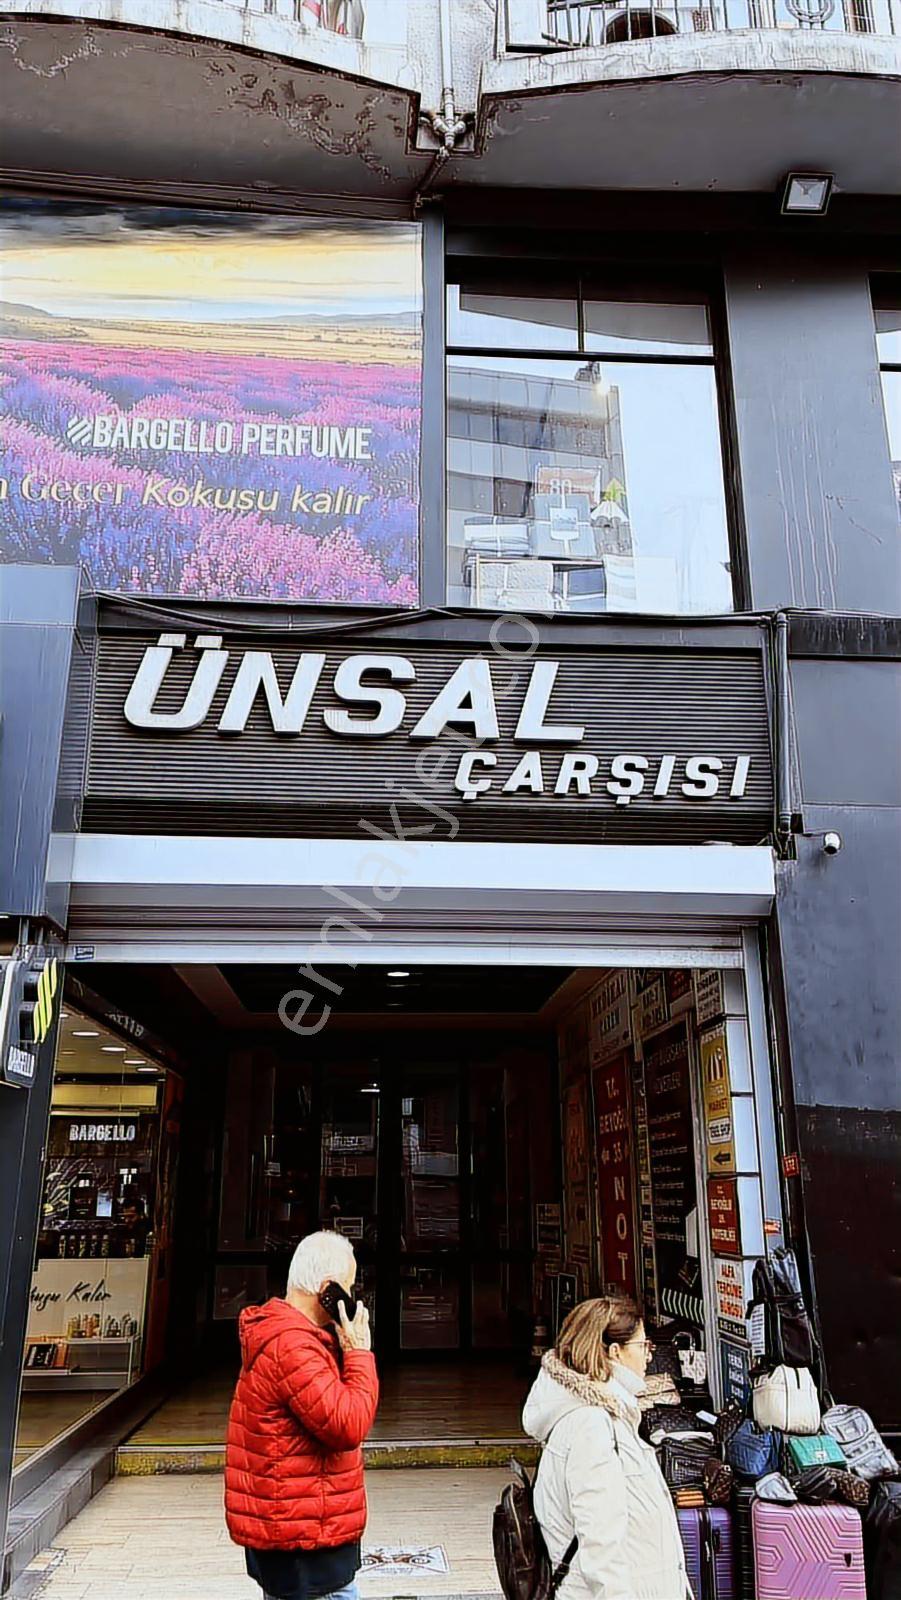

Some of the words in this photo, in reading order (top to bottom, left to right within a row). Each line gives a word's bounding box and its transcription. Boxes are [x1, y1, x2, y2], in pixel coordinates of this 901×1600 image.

[93, 416, 234, 453] BARGELLO
[241, 422, 373, 460] PERFUME
[21, 472, 130, 510] Geçer
[141, 476, 278, 513] Kokusu
[290, 483, 371, 516] kalır
[123, 633, 586, 745] ÜNSAL
[454, 750, 751, 806] ÇARŞISI
[7, 1046, 35, 1078] BARGELLO
[69, 1124, 136, 1141] BARGELLO
